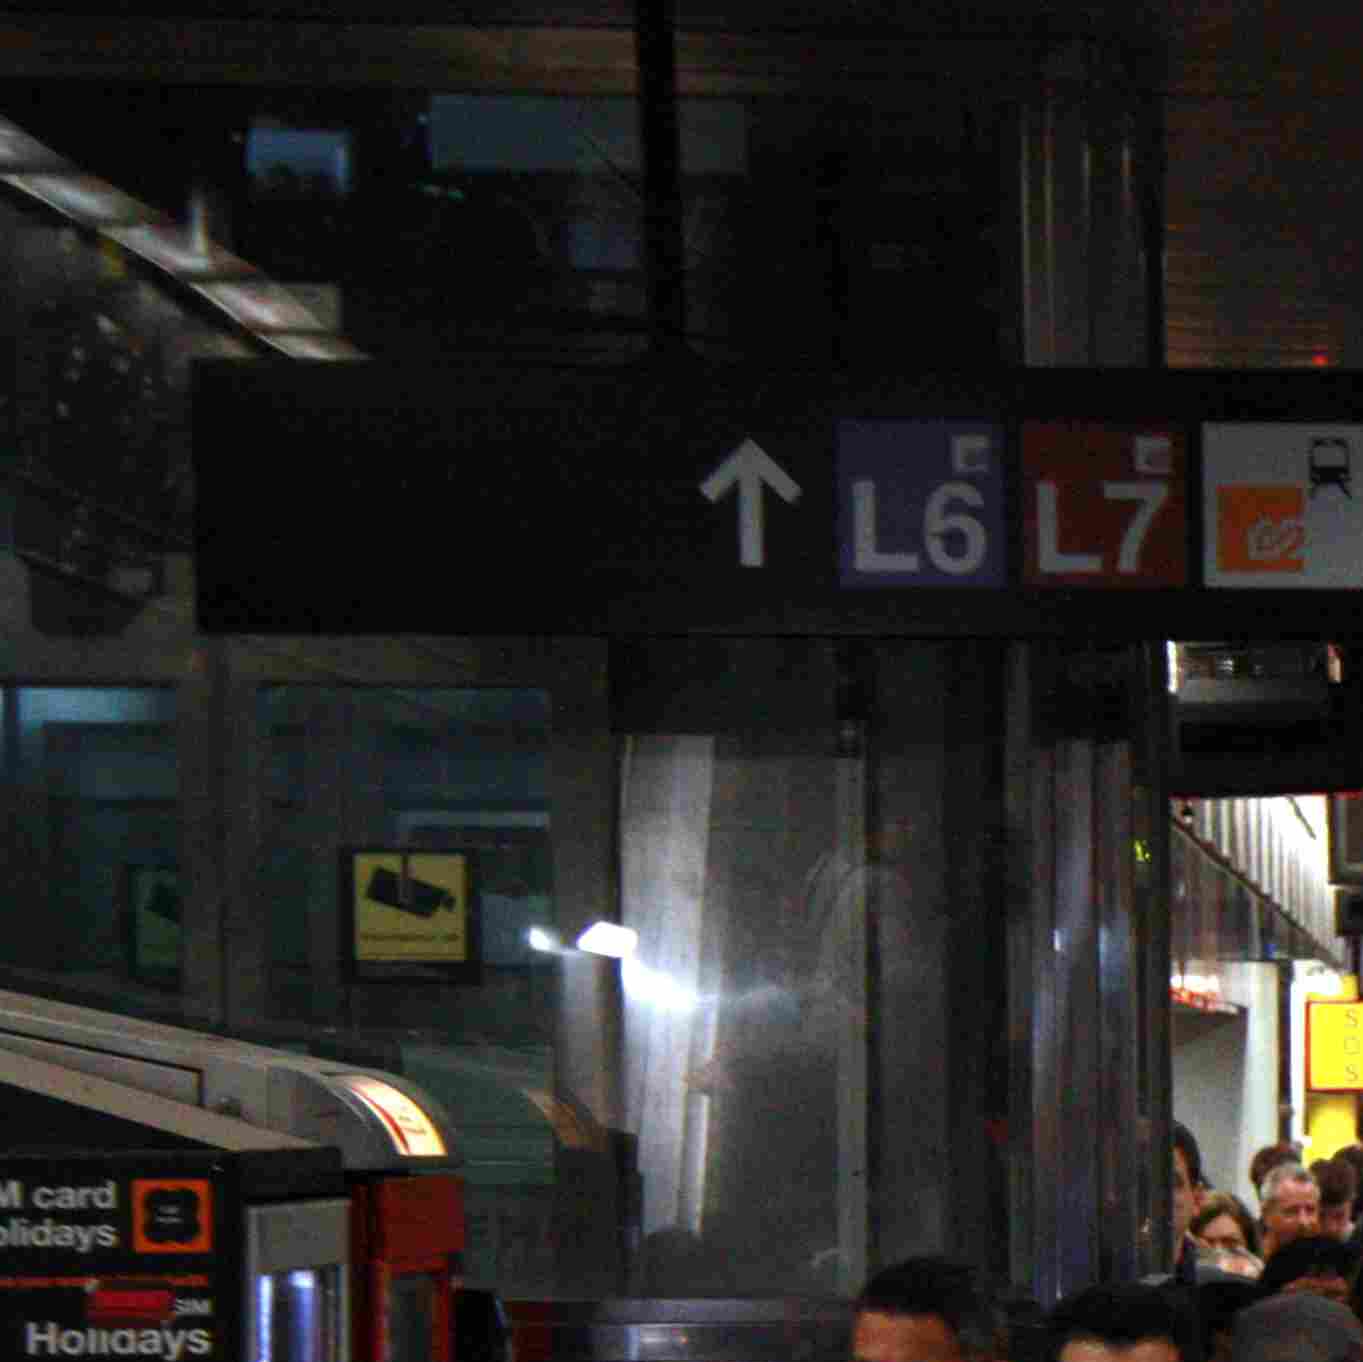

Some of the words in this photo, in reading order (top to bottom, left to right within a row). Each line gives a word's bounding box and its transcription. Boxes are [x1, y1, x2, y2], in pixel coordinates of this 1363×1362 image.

[850, 479, 988, 576] L6
[1037, 480, 1169, 573] L7
[31, 1177, 119, 1210] card
